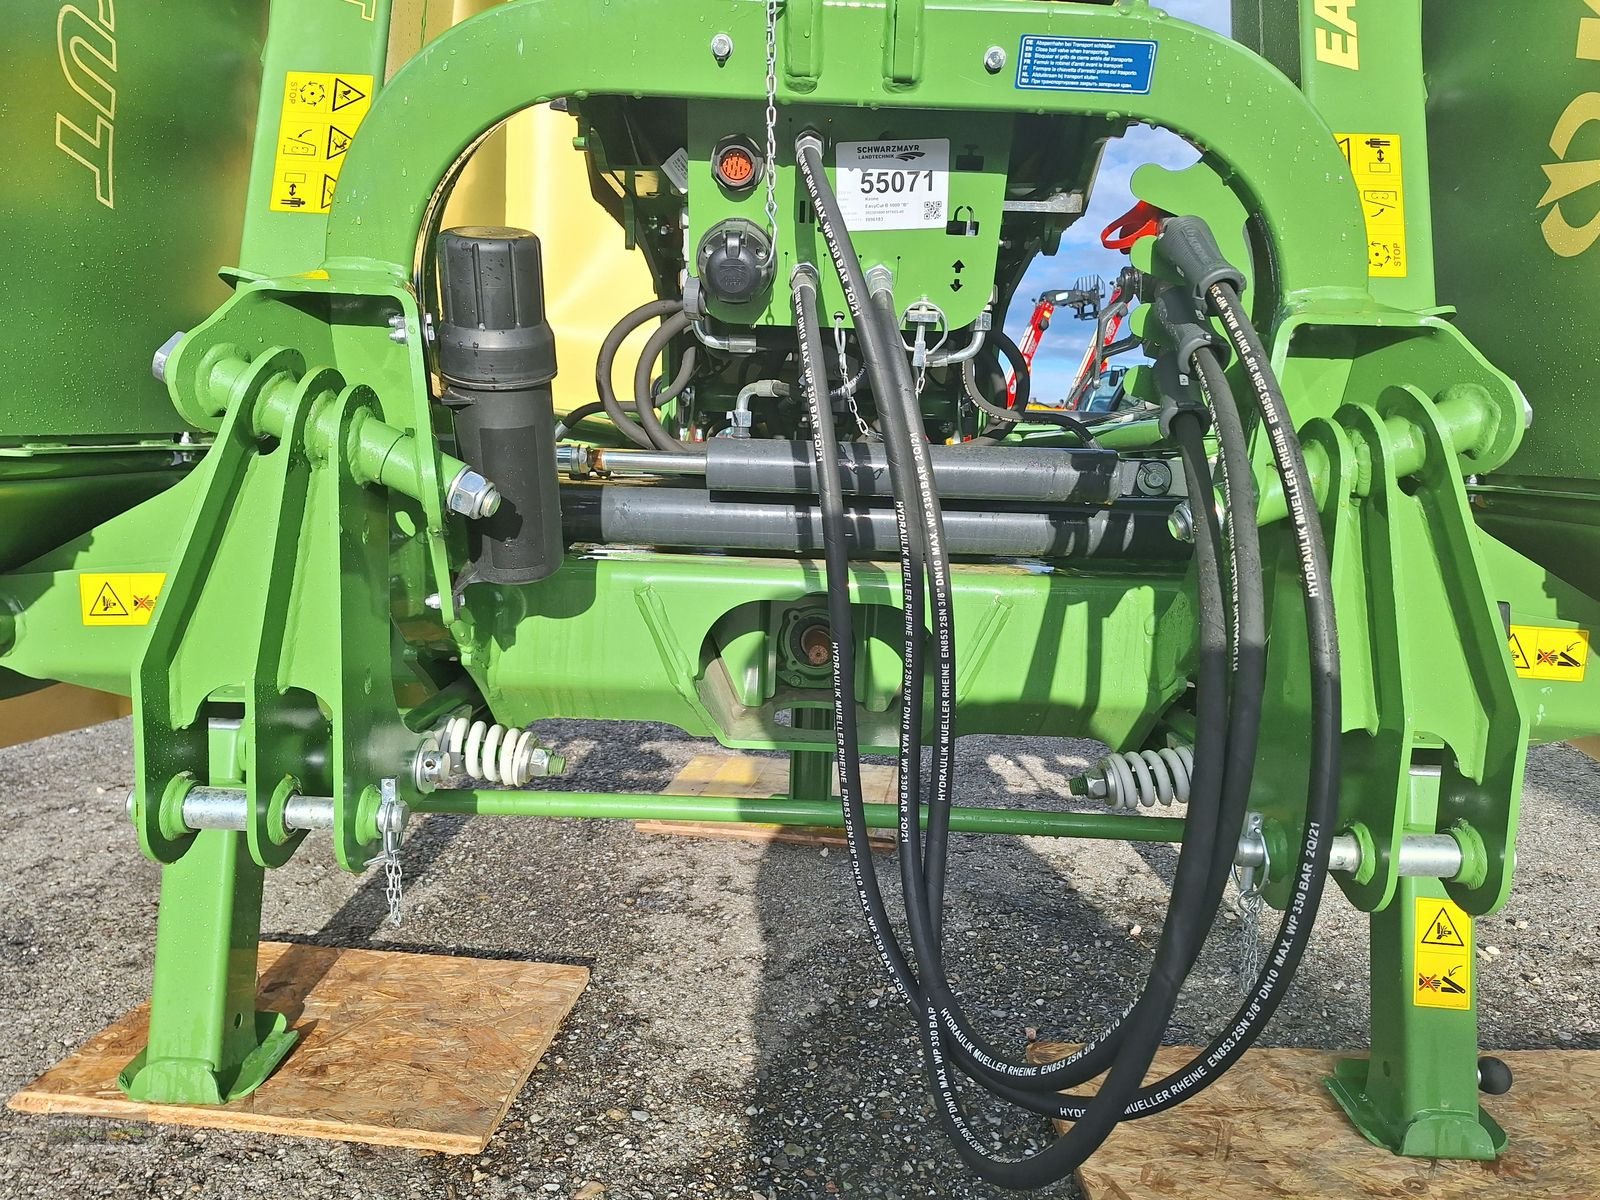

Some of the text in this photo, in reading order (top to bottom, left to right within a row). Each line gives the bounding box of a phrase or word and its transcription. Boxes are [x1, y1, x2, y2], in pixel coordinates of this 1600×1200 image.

[56, 0, 117, 208] UT
[857, 144, 920, 154] SCHWARZMAYR
[861, 170, 933, 193] 55071
[806, 174, 818, 198] DN10
[813, 198, 825, 224] MAX.
[822, 222, 833, 238] WP
[829, 236, 840, 259] 330
[836, 258, 849, 284] BAR
[845, 287, 860, 317] 2Q/21
[1393, 243, 1401, 267] STOP
[1216, 295, 1228, 310] WP
[798, 316, 806, 339] DN10
[801, 342, 810, 367] MAX.
[1234, 330, 1251, 354] DN10
[805, 367, 813, 384] WP
[1252, 372, 1268, 391] 2SN
[810, 406, 819, 429] BAR
[1259, 390, 1279, 424] EN853
[814, 432, 824, 463] 2Q/21
[910, 432, 923, 463] 2Q/21
[1273, 428, 1292, 468] RHEINE
[917, 465, 929, 489] BAR
[921, 489, 932, 509] 330
[1285, 469, 1306, 526] MUELLER
[896, 501, 909, 556] HYDRAULIK
[926, 510, 936, 527] WP
[929, 529, 940, 555] MAX.
[934, 561, 943, 586] DN10
[1299, 526, 1319, 598] HYDRAULIK
[902, 557, 912, 602] MUELLER
[939, 608, 948, 627] 2SN
[941, 627, 949, 658] EN853
[832, 642, 842, 698] HYDRAULIK
[904, 668, 912, 688] 2SN
[942, 663, 950, 700] RHEINE
[834, 700, 844, 746] MUELLER
[941, 701, 949, 744] MUELLER
[838, 747, 847, 783] RHEINE
[901, 758, 909, 774] WP
[938, 746, 948, 801] HYDRAULIK
[842, 789, 851, 818] EN853
[844, 818, 854, 839] 2SN
[1306, 821, 1320, 858] 2Q/21
[853, 860, 863, 886] DN10
[1299, 863, 1312, 892] BAR
[859, 890, 870, 915] MAX.
[1293, 892, 1306, 916] 330
[867, 916, 877, 933] WP
[1286, 913, 1298, 938] WP
[873, 933, 884, 950] 330
[1276, 937, 1292, 967] MAX.
[881, 952, 895, 974] BAR
[893, 977, 911, 1004] 2Q/21
[1259, 969, 1279, 1000] DN10
[1249, 997, 1261, 1021] 3/8"
[930, 1030, 940, 1046] 330
[941, 1008, 975, 1053] HYDRAULIK
[972, 1049, 1006, 1074] MUELLER
[1007, 1065, 1038, 1077] RHEINE
[1041, 1060, 1065, 1075] EN853
[1233, 1019, 1250, 1041] 2SN
[933, 1049, 943, 1064] WP
[1207, 1037, 1236, 1068] EN853
[936, 1065, 949, 1088] MAX.
[1171, 1065, 1208, 1095] RHEINE
[943, 1091, 958, 1114] DN10
[960, 1128, 975, 1141] 2SN
